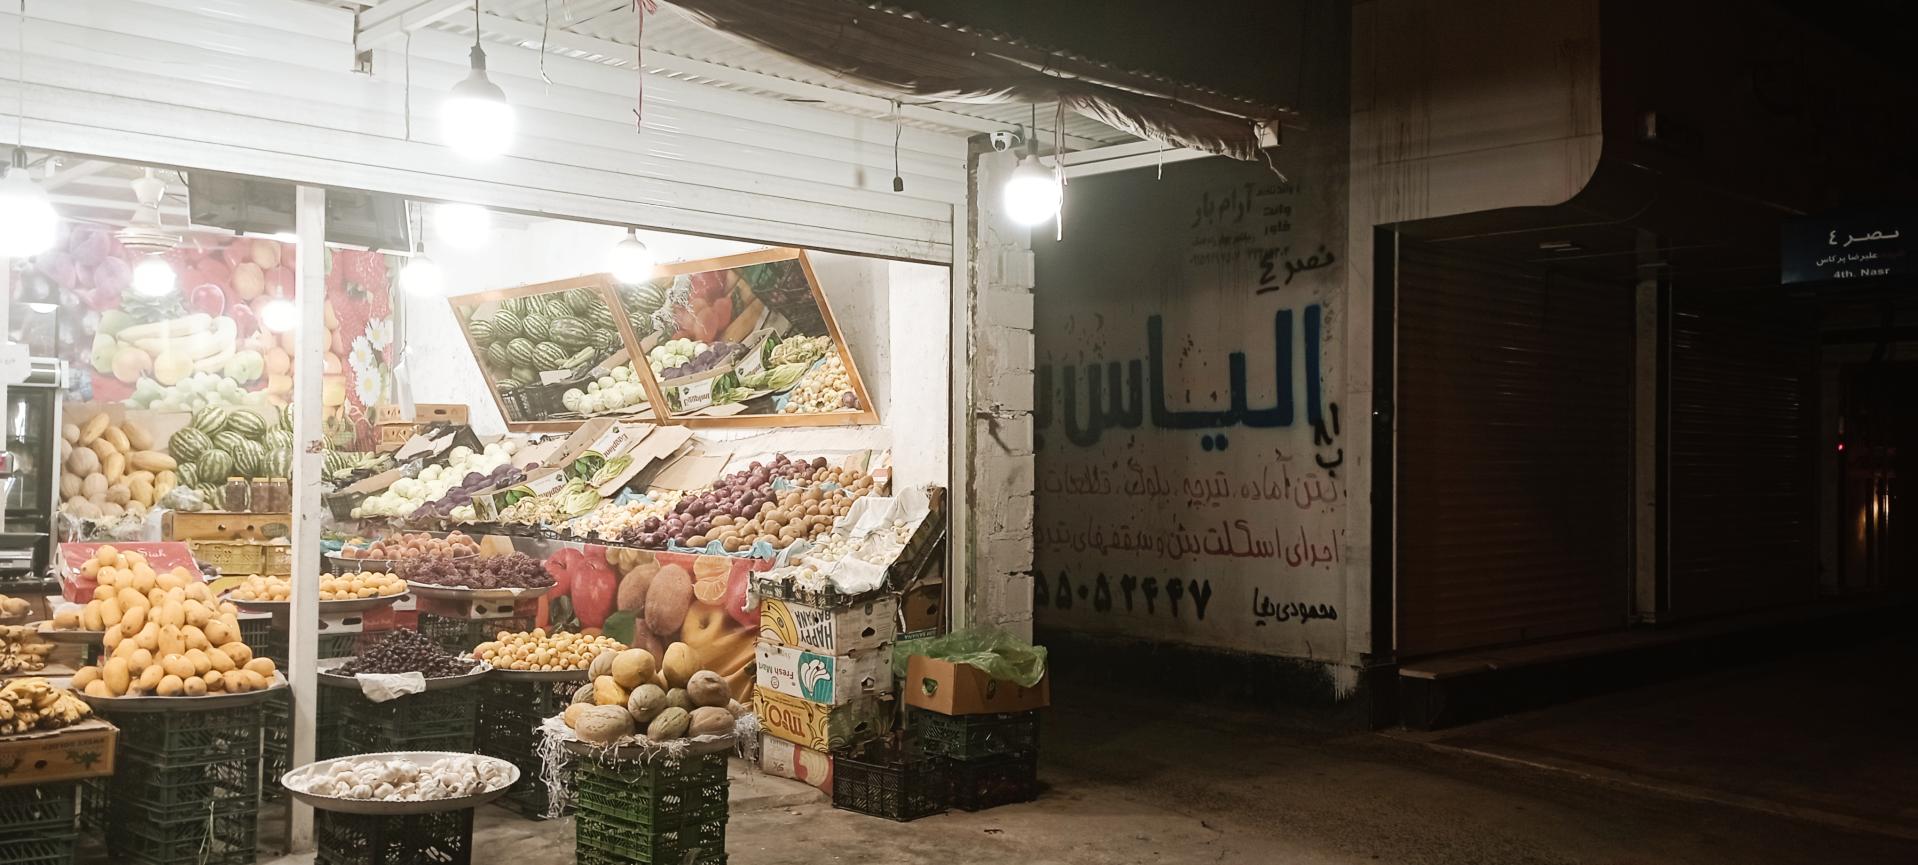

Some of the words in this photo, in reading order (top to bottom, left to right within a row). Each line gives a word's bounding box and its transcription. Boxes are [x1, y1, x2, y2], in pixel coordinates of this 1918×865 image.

[1860, 267, 1891, 277] Nasr
[1063, 303, 1322, 451] الیاس
[1203, 519, 1281, 560] اسکلت
[1286, 525, 1339, 570] اجرای
[794, 609, 831, 629] BANANA
[800, 622, 834, 650] HAPPY
[774, 667, 794, 680] Fresh
